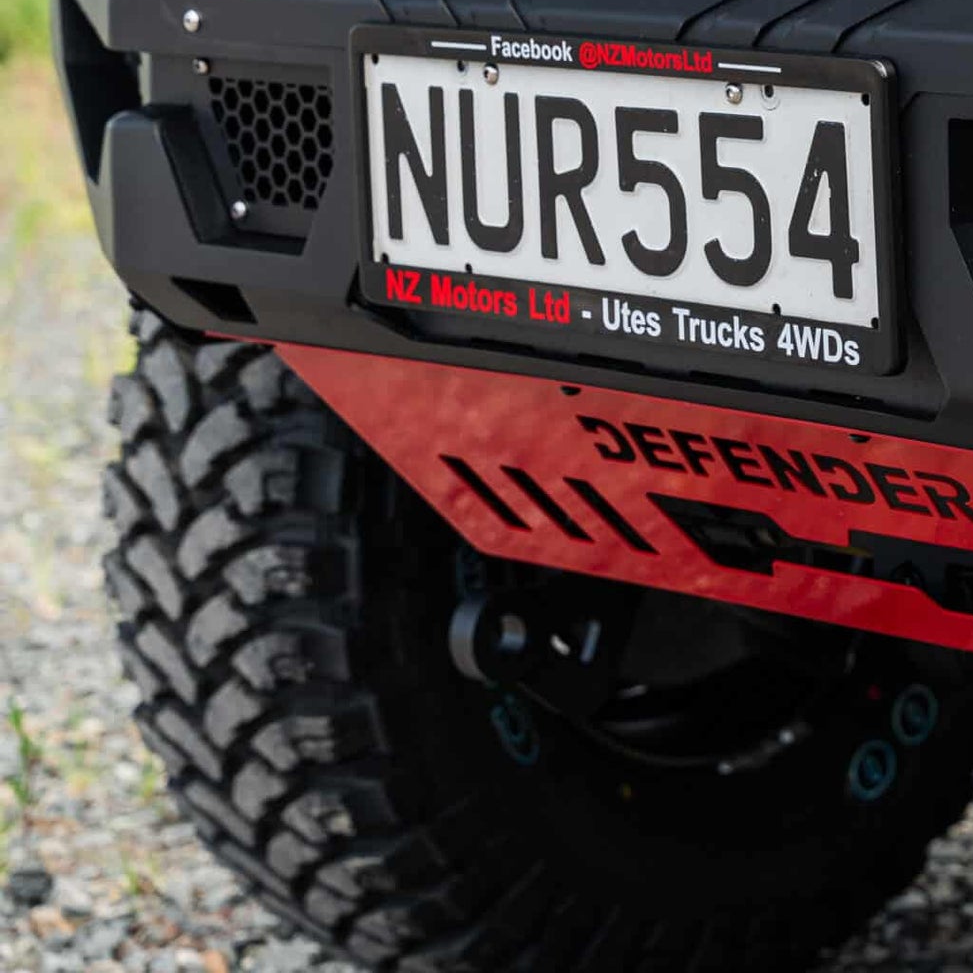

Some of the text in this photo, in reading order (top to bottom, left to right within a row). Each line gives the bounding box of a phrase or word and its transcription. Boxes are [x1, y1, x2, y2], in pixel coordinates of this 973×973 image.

[490, 35, 713, 73] Facebook @NZMotorsLtd
[381, 83, 860, 299] NUR554
[385, 268, 422, 305] NZ
[430, 273, 518, 317] Motors
[528, 287, 571, 324] Ltd
[602, 297, 662, 337] Utes
[672, 306, 765, 352] Trucks
[777, 322, 860, 366] 4WDs
